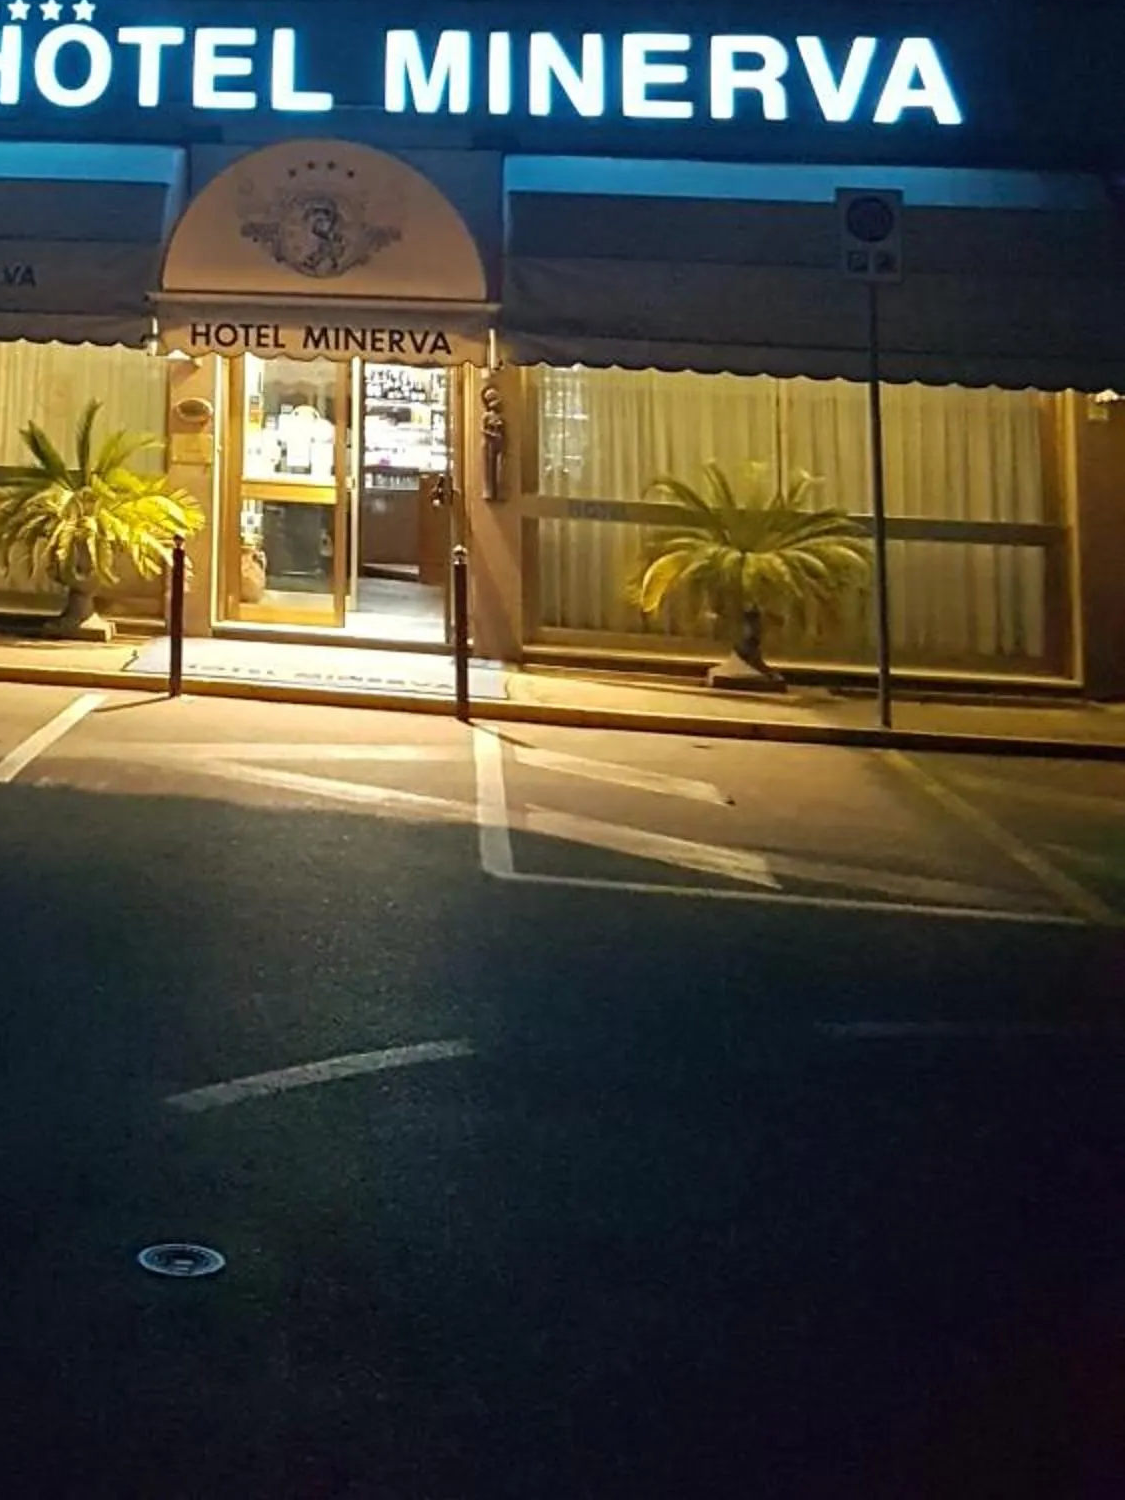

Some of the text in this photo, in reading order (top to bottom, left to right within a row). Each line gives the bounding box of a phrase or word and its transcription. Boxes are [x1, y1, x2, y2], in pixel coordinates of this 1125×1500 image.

[383, 29, 963, 125] MINERVA
[191, 322, 453, 355] HOTEL MINERVA
